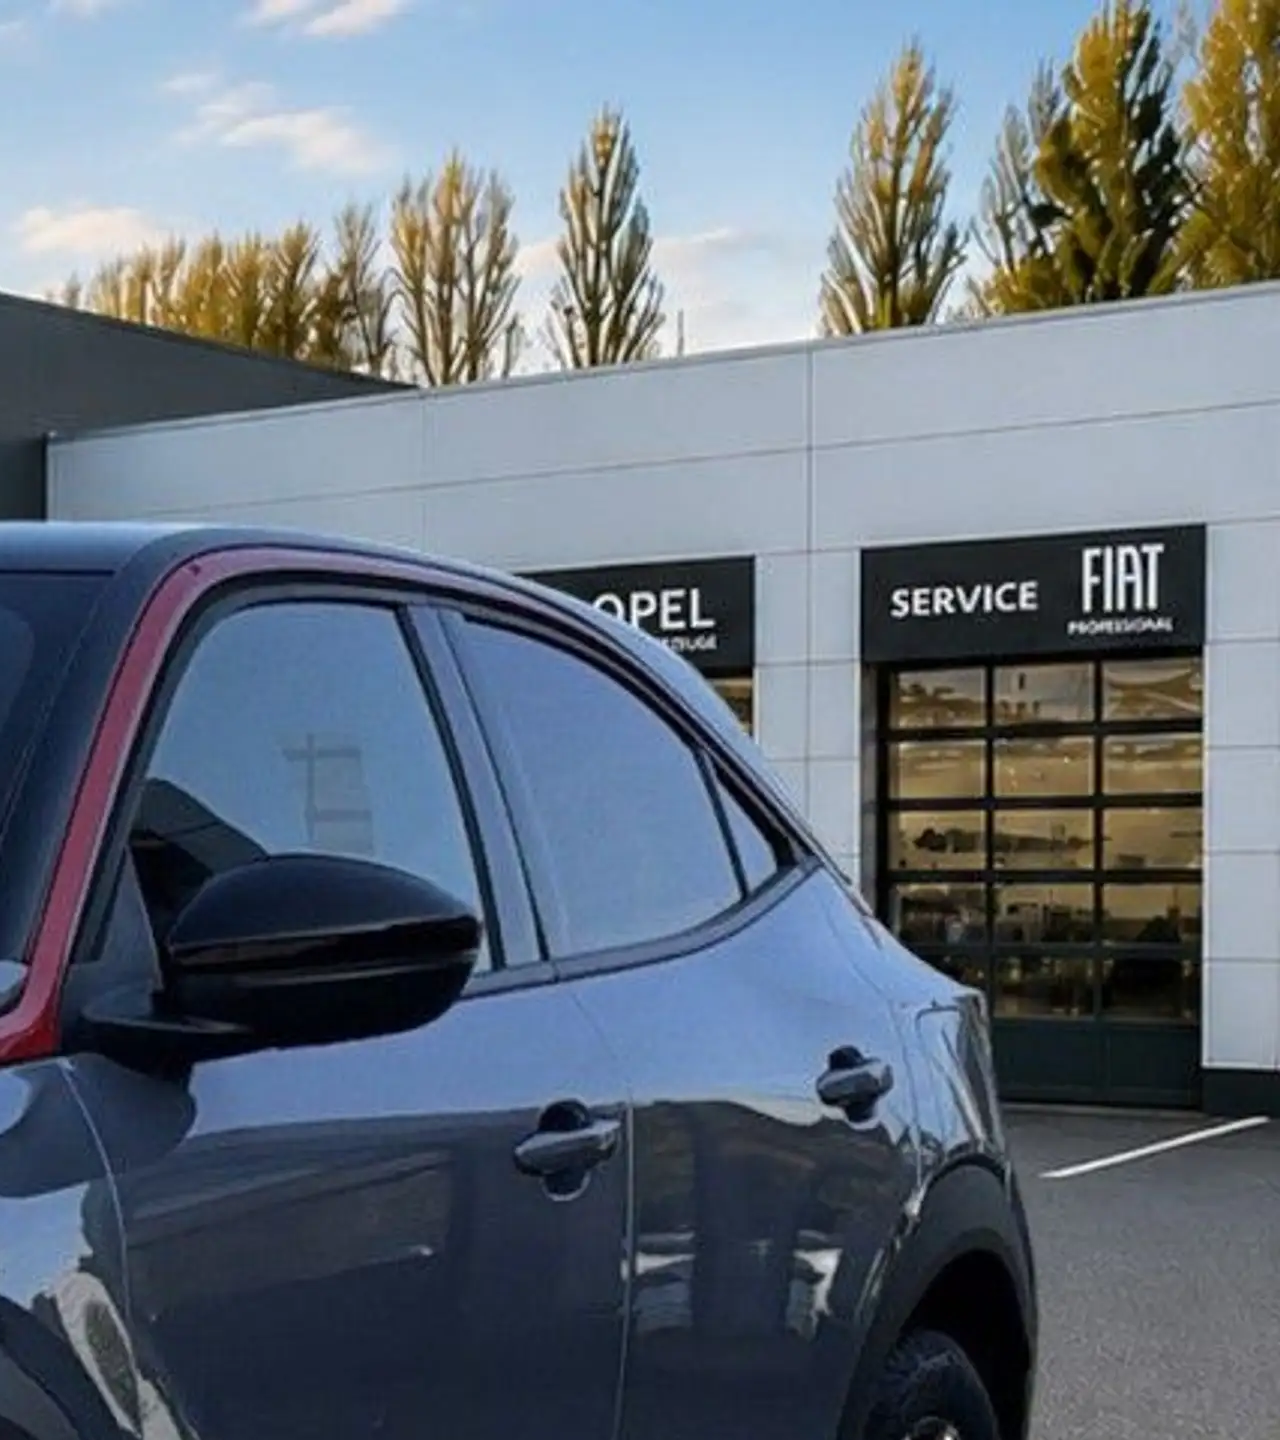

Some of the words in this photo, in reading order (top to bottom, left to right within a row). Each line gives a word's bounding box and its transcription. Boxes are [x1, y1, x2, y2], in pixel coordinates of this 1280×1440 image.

[890, 581, 1039, 618] SERVICE
[1082, 543, 1165, 613] FIAT
[1067, 617, 1174, 635] PROFESSIONAL
